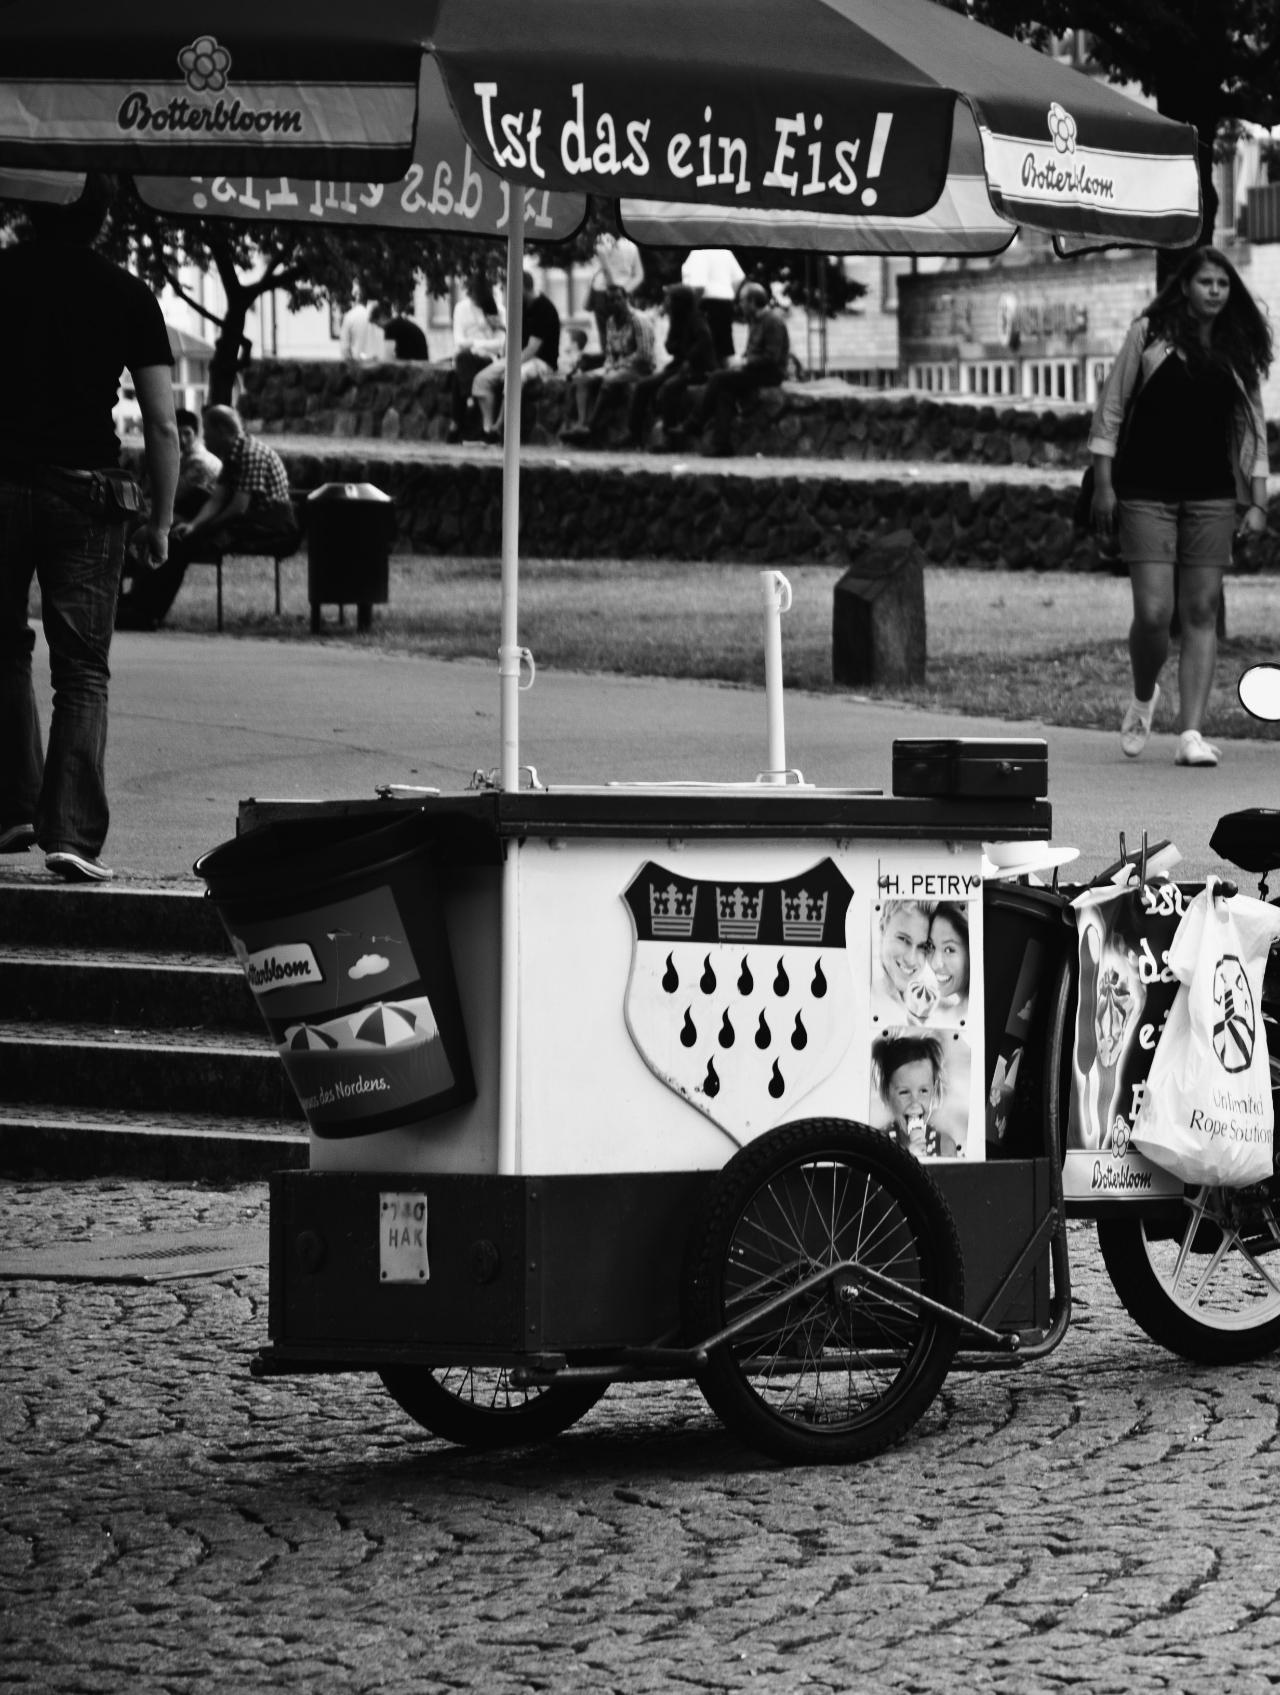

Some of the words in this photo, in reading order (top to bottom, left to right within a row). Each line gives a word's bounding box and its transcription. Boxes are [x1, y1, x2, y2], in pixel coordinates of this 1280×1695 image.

[117, 91, 303, 133] Botterbloom
[473, 81, 545, 179] Ist
[560, 82, 650, 176] das
[666, 104, 751, 195] ein
[762, 111, 894, 208] Eis!
[1021, 152, 1114, 199] Botterbloom
[911, 874, 974, 895] PETRY
[334, 1074, 391, 1100] Nordens.
[1189, 1109, 1229, 1141] Rope
[1091, 1159, 1153, 1190] Botterbloom
[388, 1226, 424, 1249] HAK
